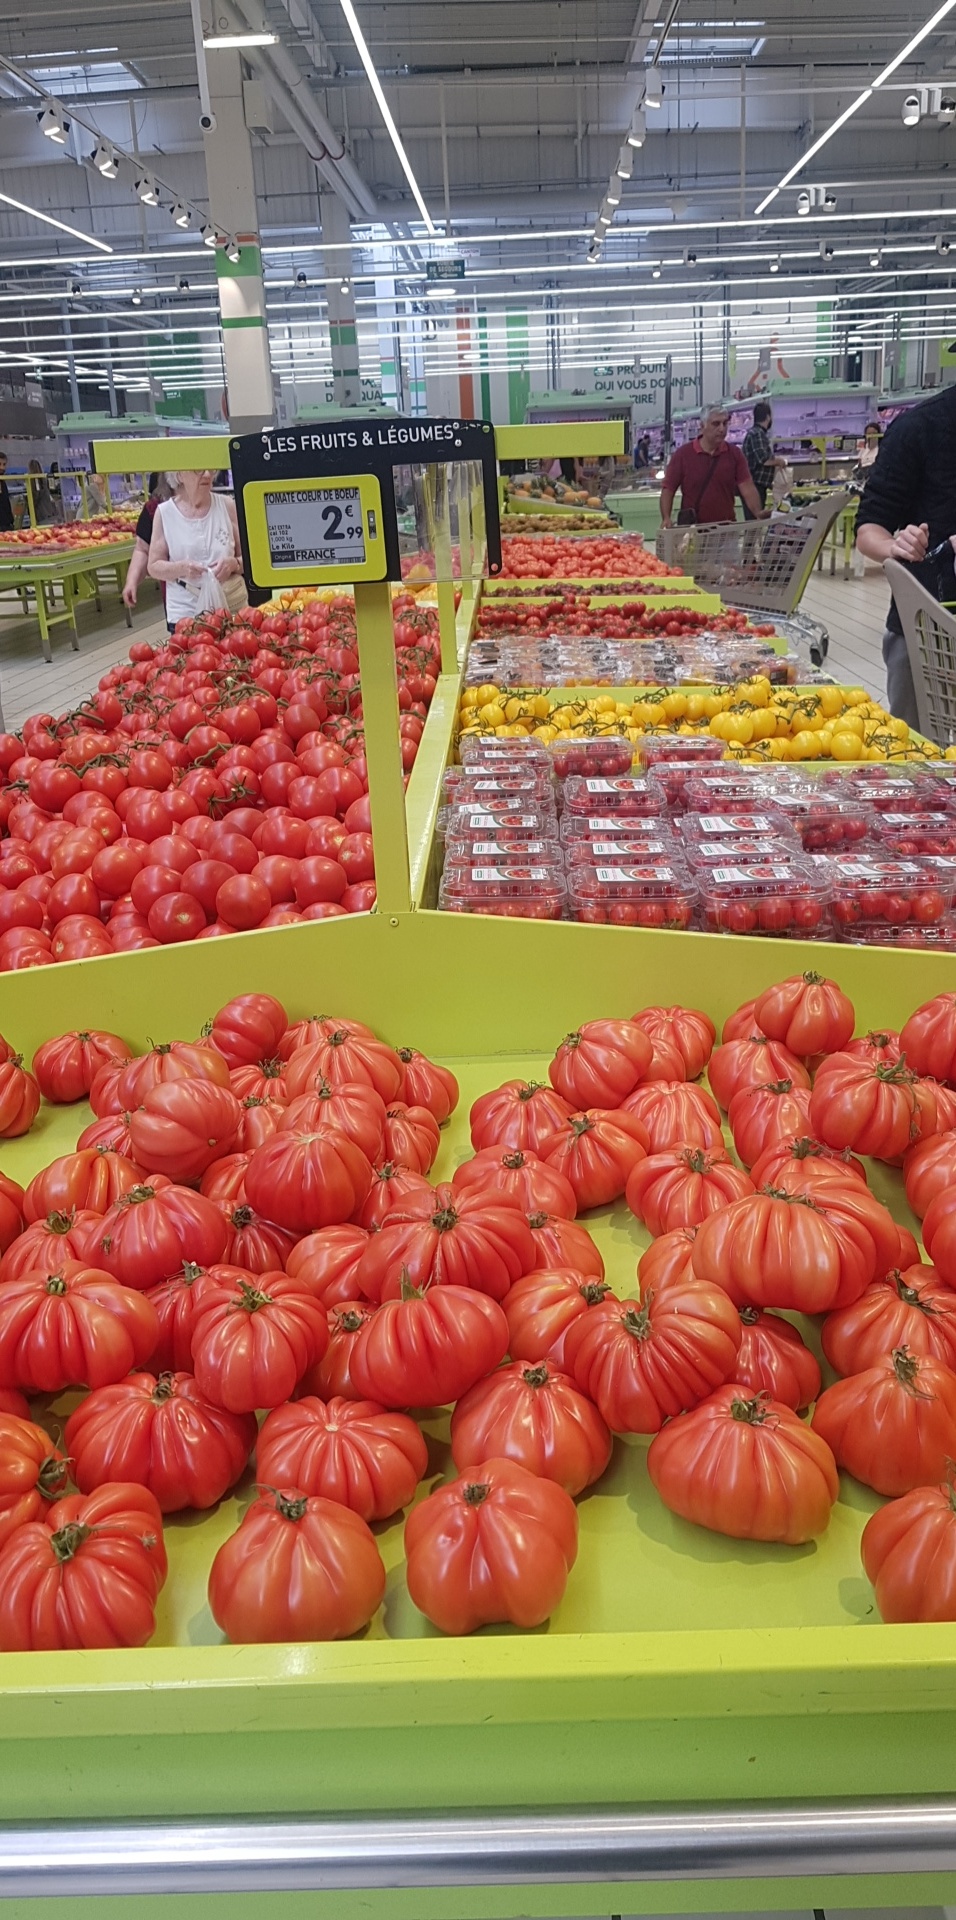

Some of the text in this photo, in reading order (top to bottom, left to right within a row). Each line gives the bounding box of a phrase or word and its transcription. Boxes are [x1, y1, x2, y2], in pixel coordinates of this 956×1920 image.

[594, 380, 614, 391] QUI
[617, 379, 647, 390] VOUS
[267, 425, 454, 453] LES FRUITS & LÉGUMES
[265, 488, 359, 504] TOMATE COEUR DE BOEUF
[321, 505, 363, 540] 2 € 99
[295, 549, 336, 560] FRANCE
